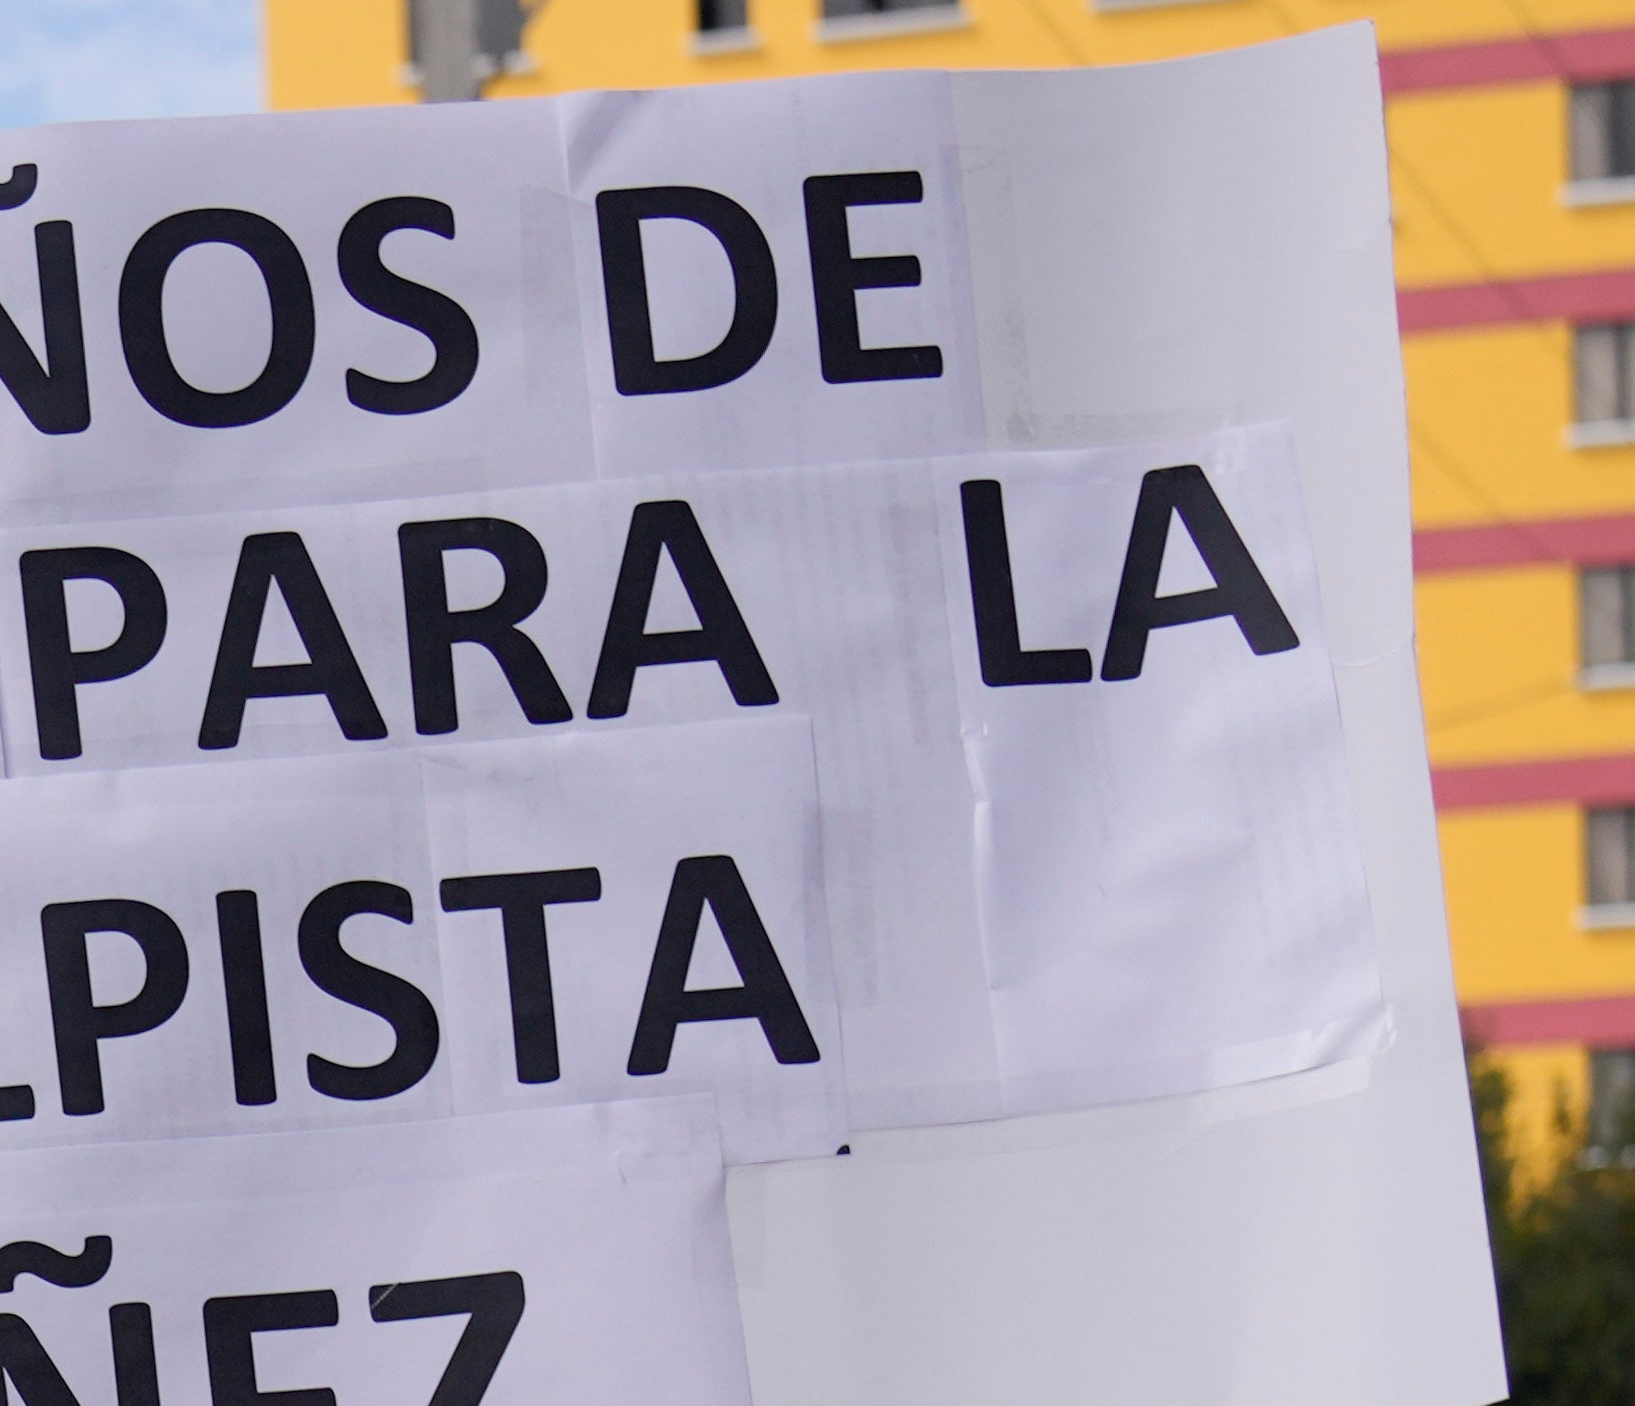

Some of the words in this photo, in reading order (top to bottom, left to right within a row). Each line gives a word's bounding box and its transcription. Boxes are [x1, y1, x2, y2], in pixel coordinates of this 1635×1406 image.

[594, 169, 945, 398] DE
[18, 498, 781, 762] PARA
[958, 463, 1301, 689] LA
